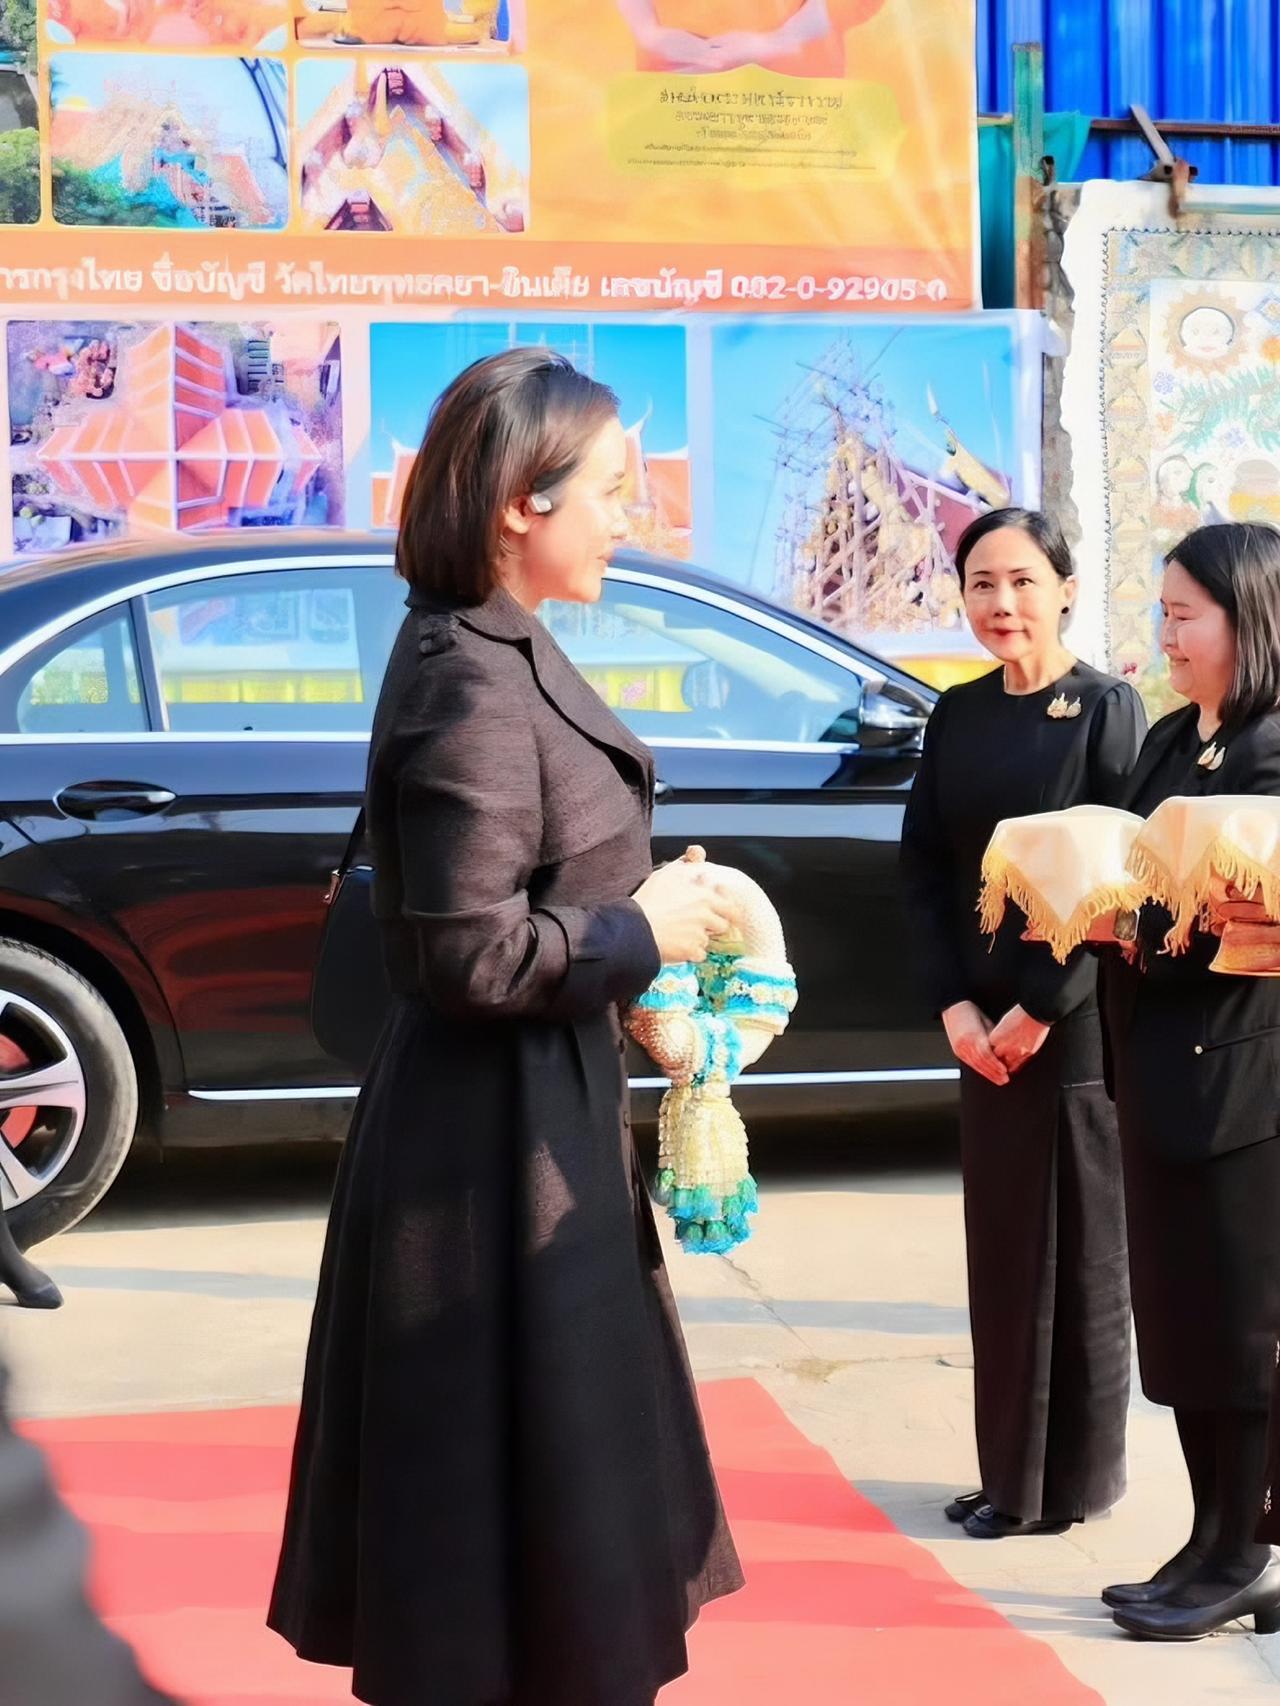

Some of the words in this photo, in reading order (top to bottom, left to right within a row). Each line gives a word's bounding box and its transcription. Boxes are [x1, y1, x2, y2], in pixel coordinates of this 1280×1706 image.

[151, 252, 265, 300] ชื่อบัญชี
[601, 267, 723, 305] เลขบัญชี
